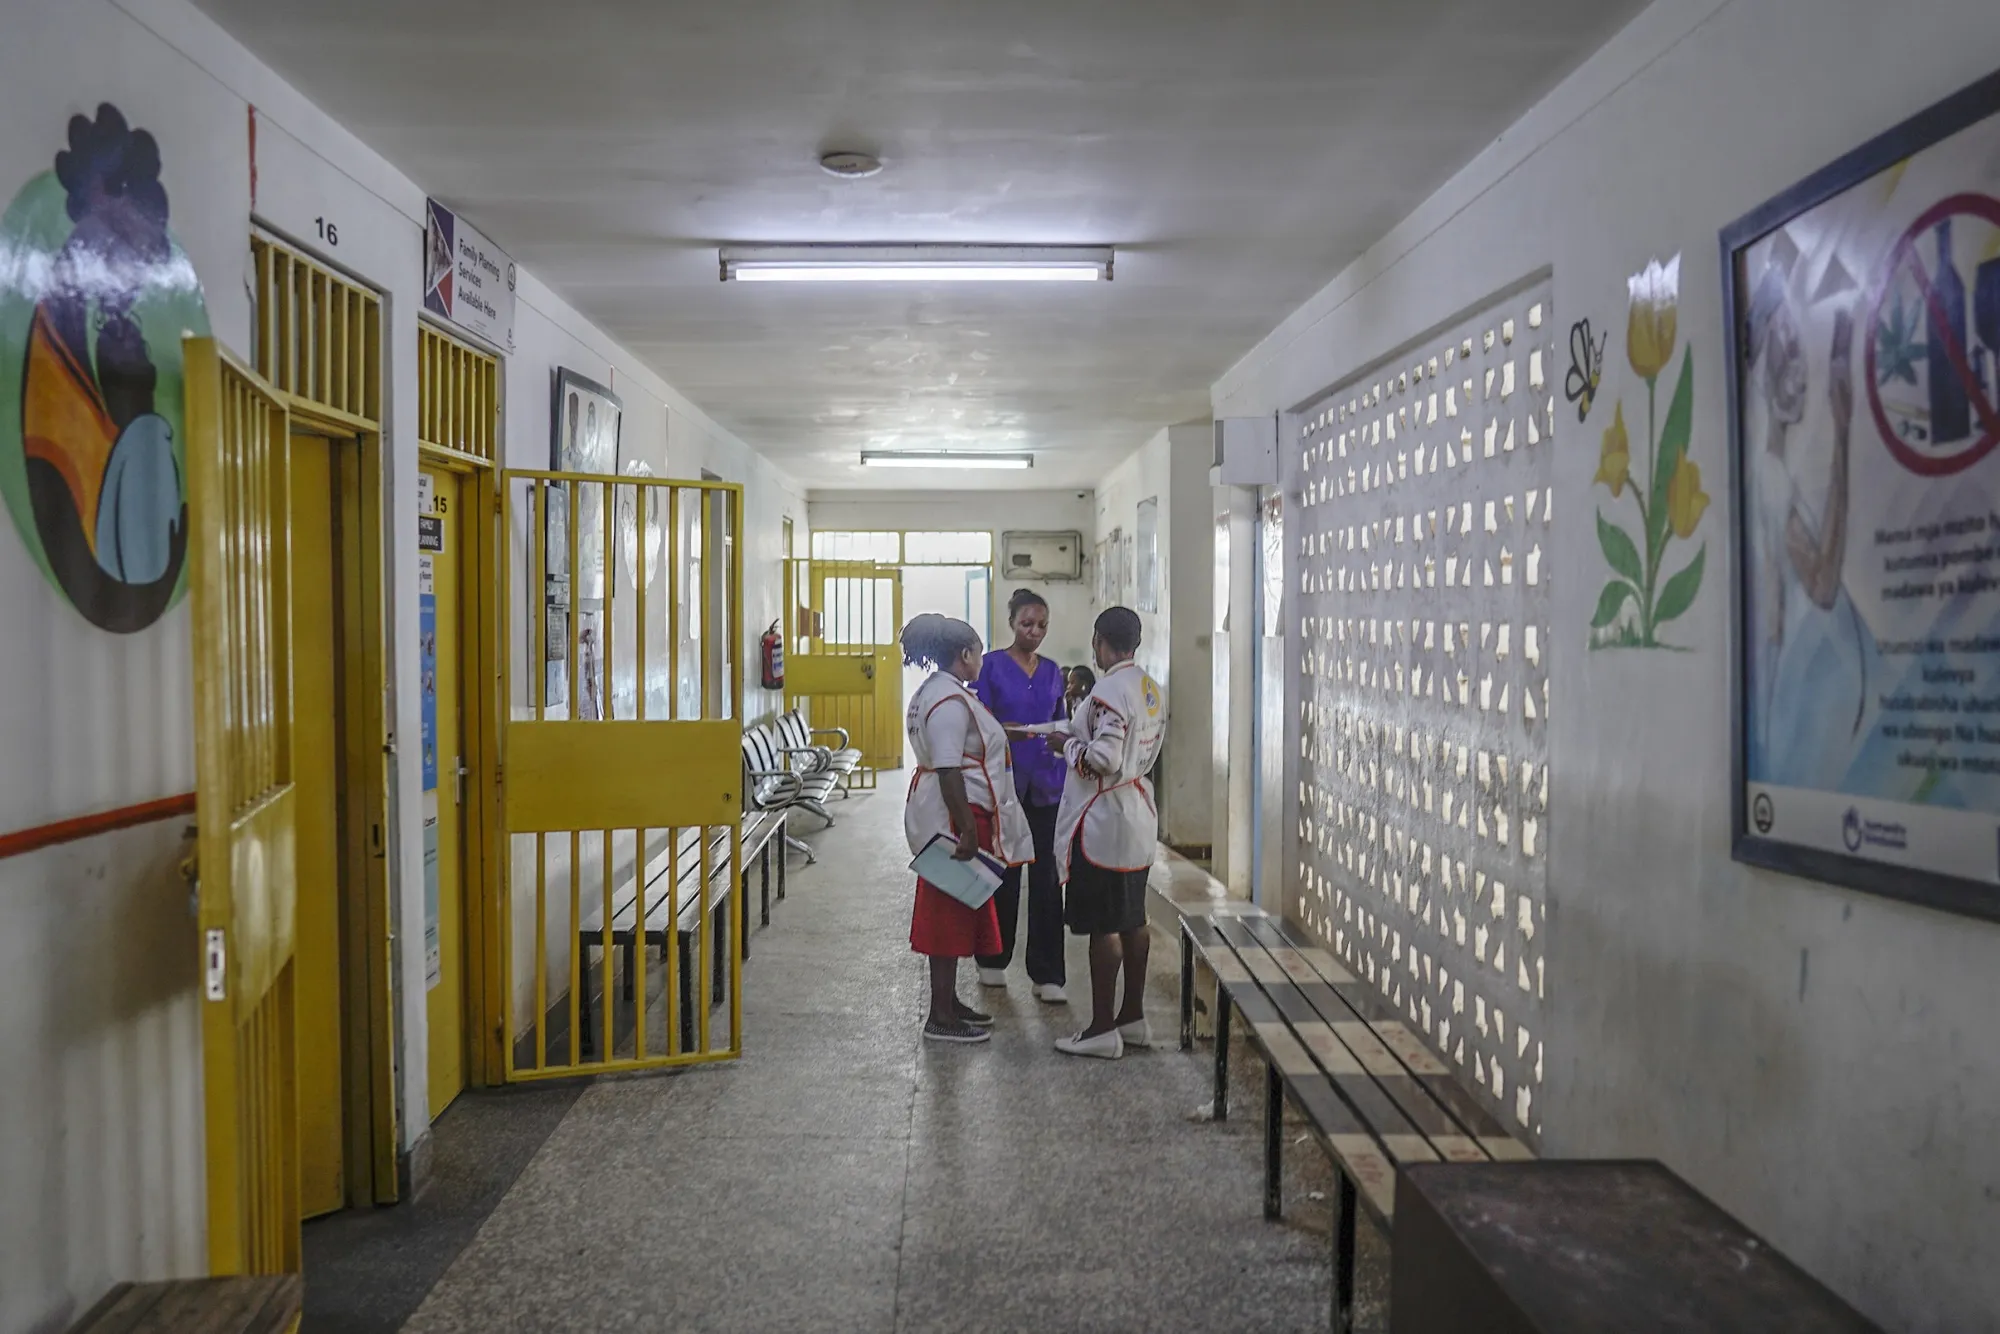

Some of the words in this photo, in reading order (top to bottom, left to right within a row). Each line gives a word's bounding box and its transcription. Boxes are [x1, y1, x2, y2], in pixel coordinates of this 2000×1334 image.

[315, 216, 338, 247] 16
[459, 238, 477, 267] Family
[479, 250, 500, 282] Planning
[459, 261, 482, 289] Services
[458, 285, 483, 312] Available
[484, 299, 497, 320] Here
[433, 495, 447, 513] 15
[419, 534, 440, 547] LANNING
